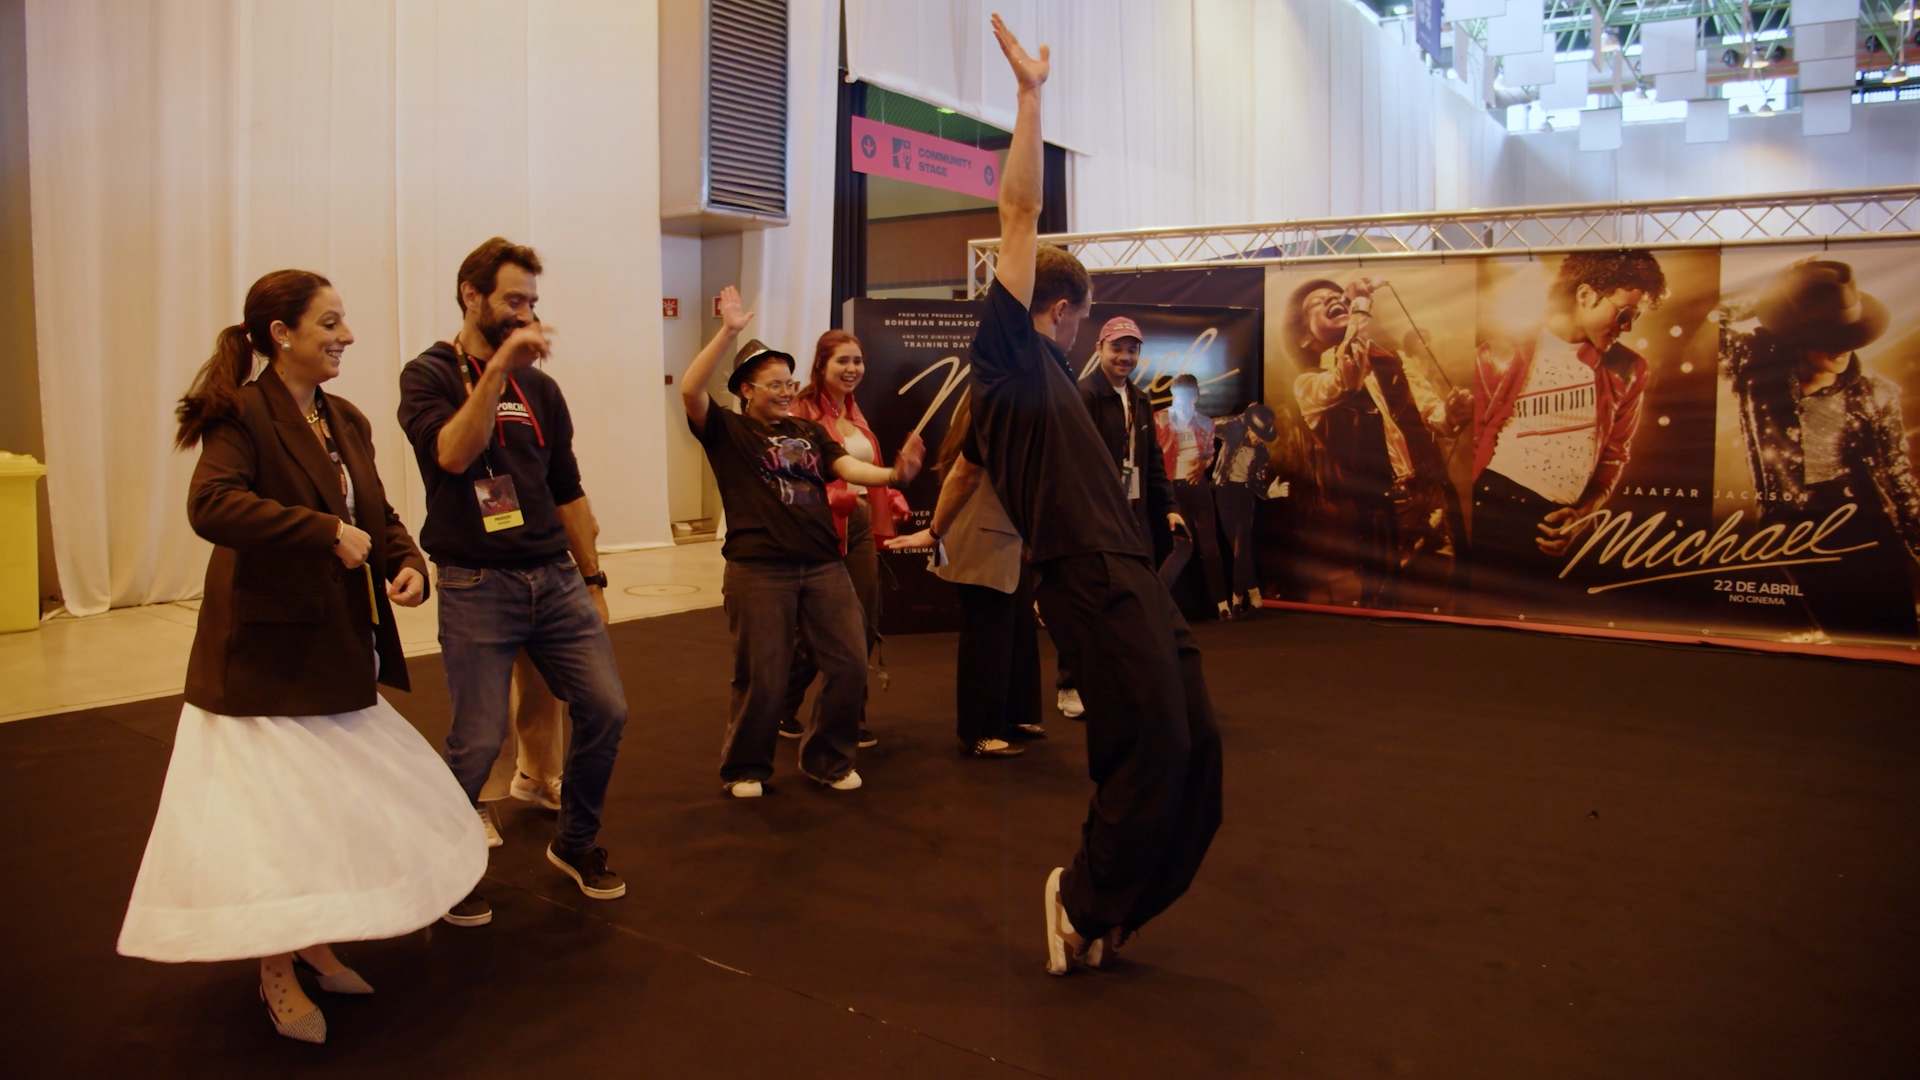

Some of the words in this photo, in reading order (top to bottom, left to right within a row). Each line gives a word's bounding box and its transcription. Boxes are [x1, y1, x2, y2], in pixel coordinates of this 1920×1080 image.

[918, 147, 973, 170] COMMUNITY
[918, 161, 948, 177] STAGE
[1623, 486, 1699, 498] JAAFAR
[1713, 490, 1809, 502] JACKSON
[1559, 503, 1878, 579] Michael
[1713, 579, 1733, 592] 22
[1735, 580, 1756, 593] DE
[1758, 581, 1804, 596] ABRIL
[1729, 594, 1745, 603] NO
[1745, 594, 1786, 606] CINEMA
